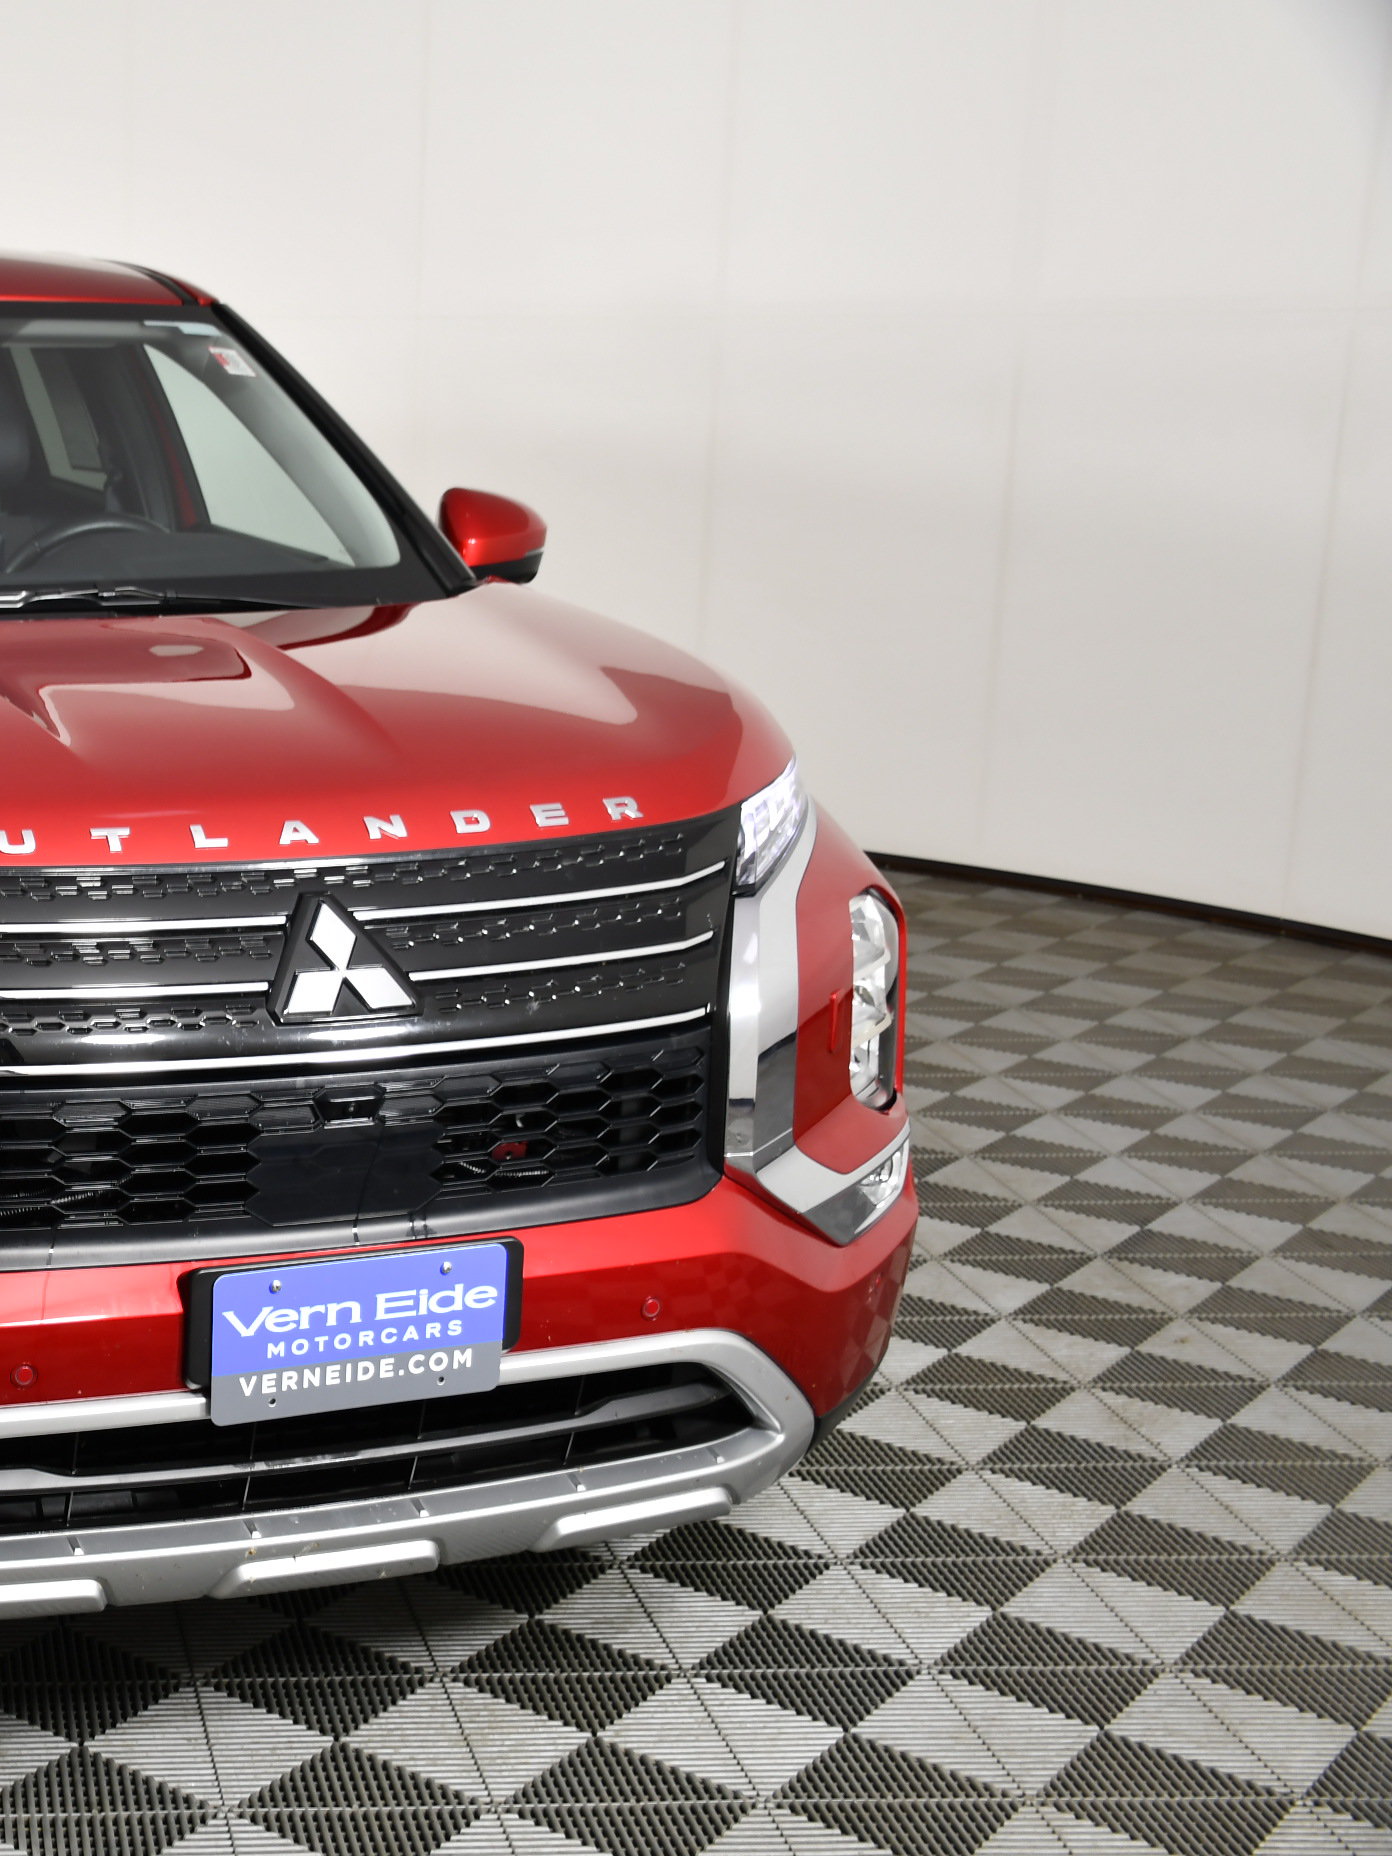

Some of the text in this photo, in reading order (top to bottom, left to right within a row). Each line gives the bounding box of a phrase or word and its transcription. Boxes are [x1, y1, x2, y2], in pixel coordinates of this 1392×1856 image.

[222, 1283, 498, 1338] Vern Eide
[266, 1319, 463, 1359] MOTORCARS
[239, 1348, 473, 1397] VERNEIDE.COM
